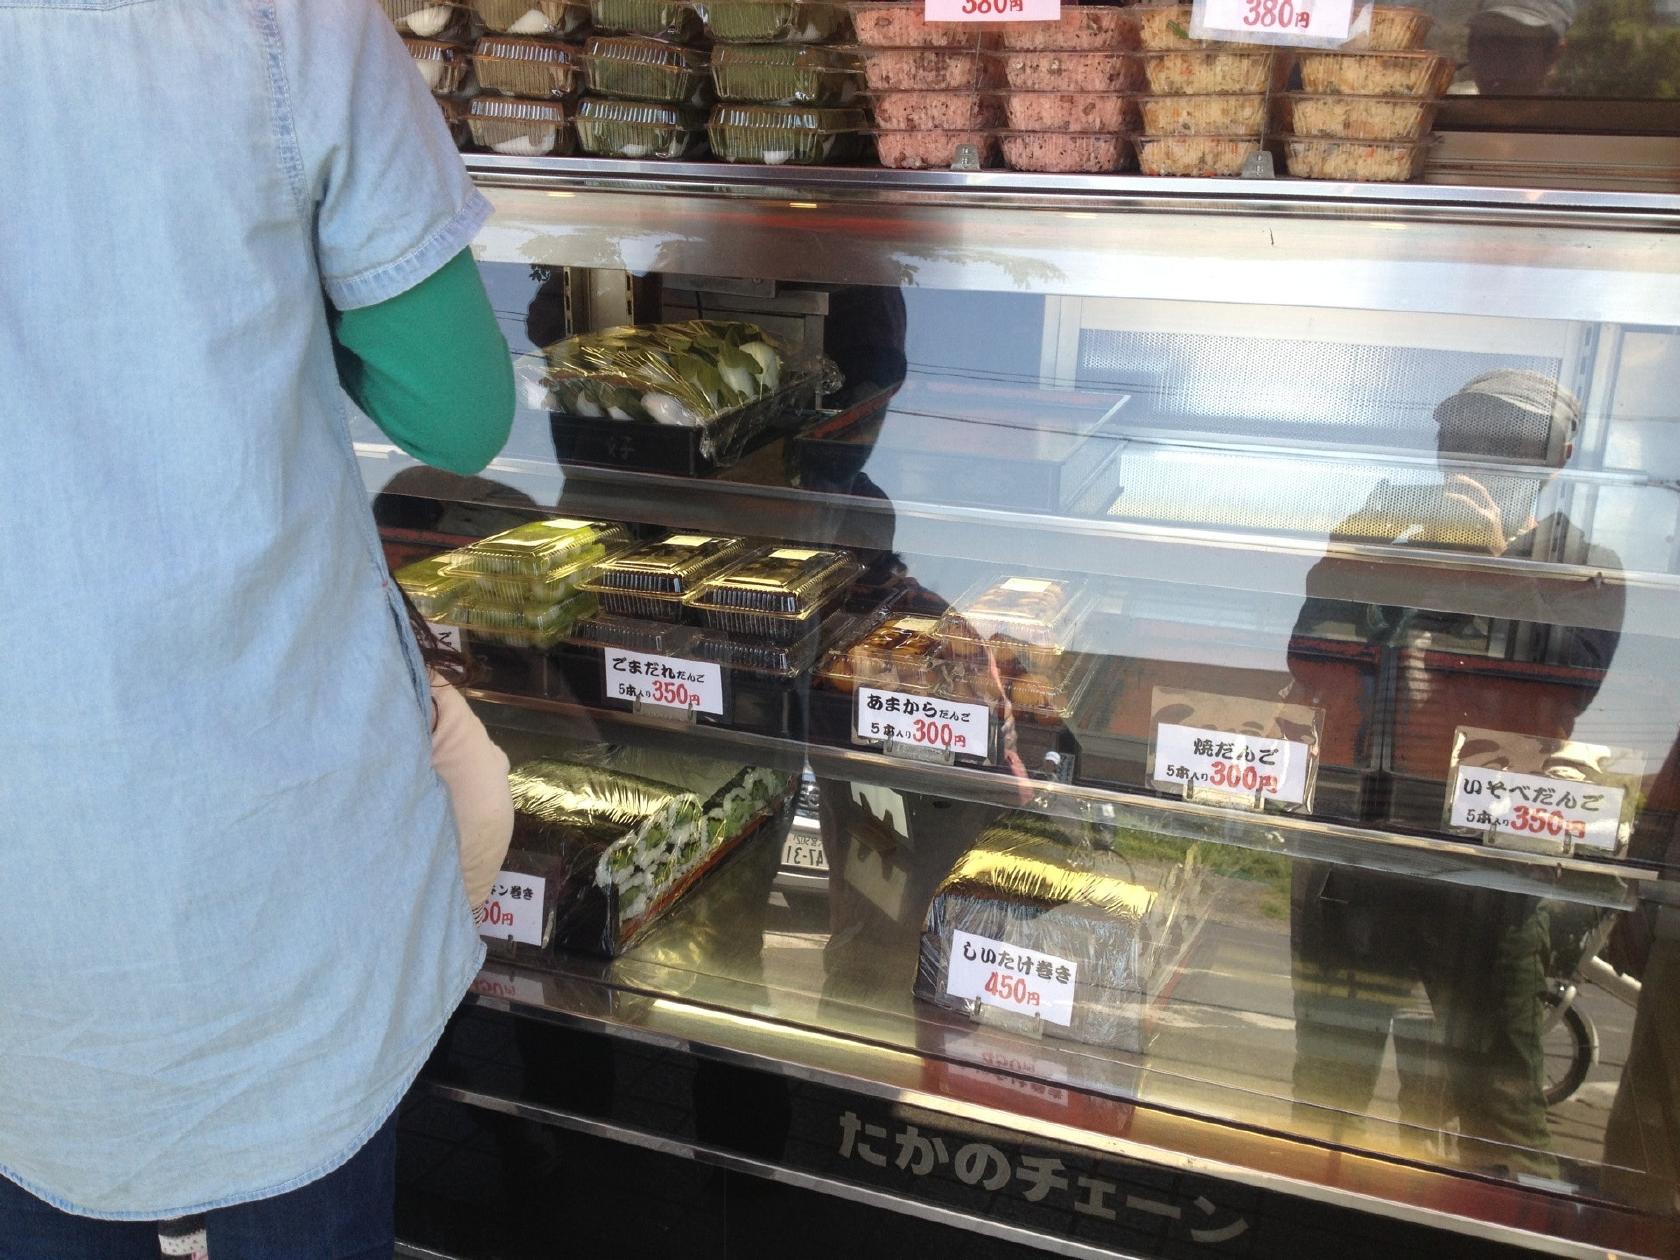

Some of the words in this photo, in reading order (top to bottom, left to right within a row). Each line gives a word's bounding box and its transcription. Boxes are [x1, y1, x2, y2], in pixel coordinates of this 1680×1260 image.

[1243, 0, 1310, 28] 380円
[612, 657, 705, 683] ごまだれだんご
[867, 693, 971, 723] あまからだんご
[1193, 737, 1280, 766] 焼だんご
[963, 941, 1072, 985] しいたけ巻き
[984, 971, 1041, 1006] 450円
[838, 1110, 1250, 1243] たかのチェーン
